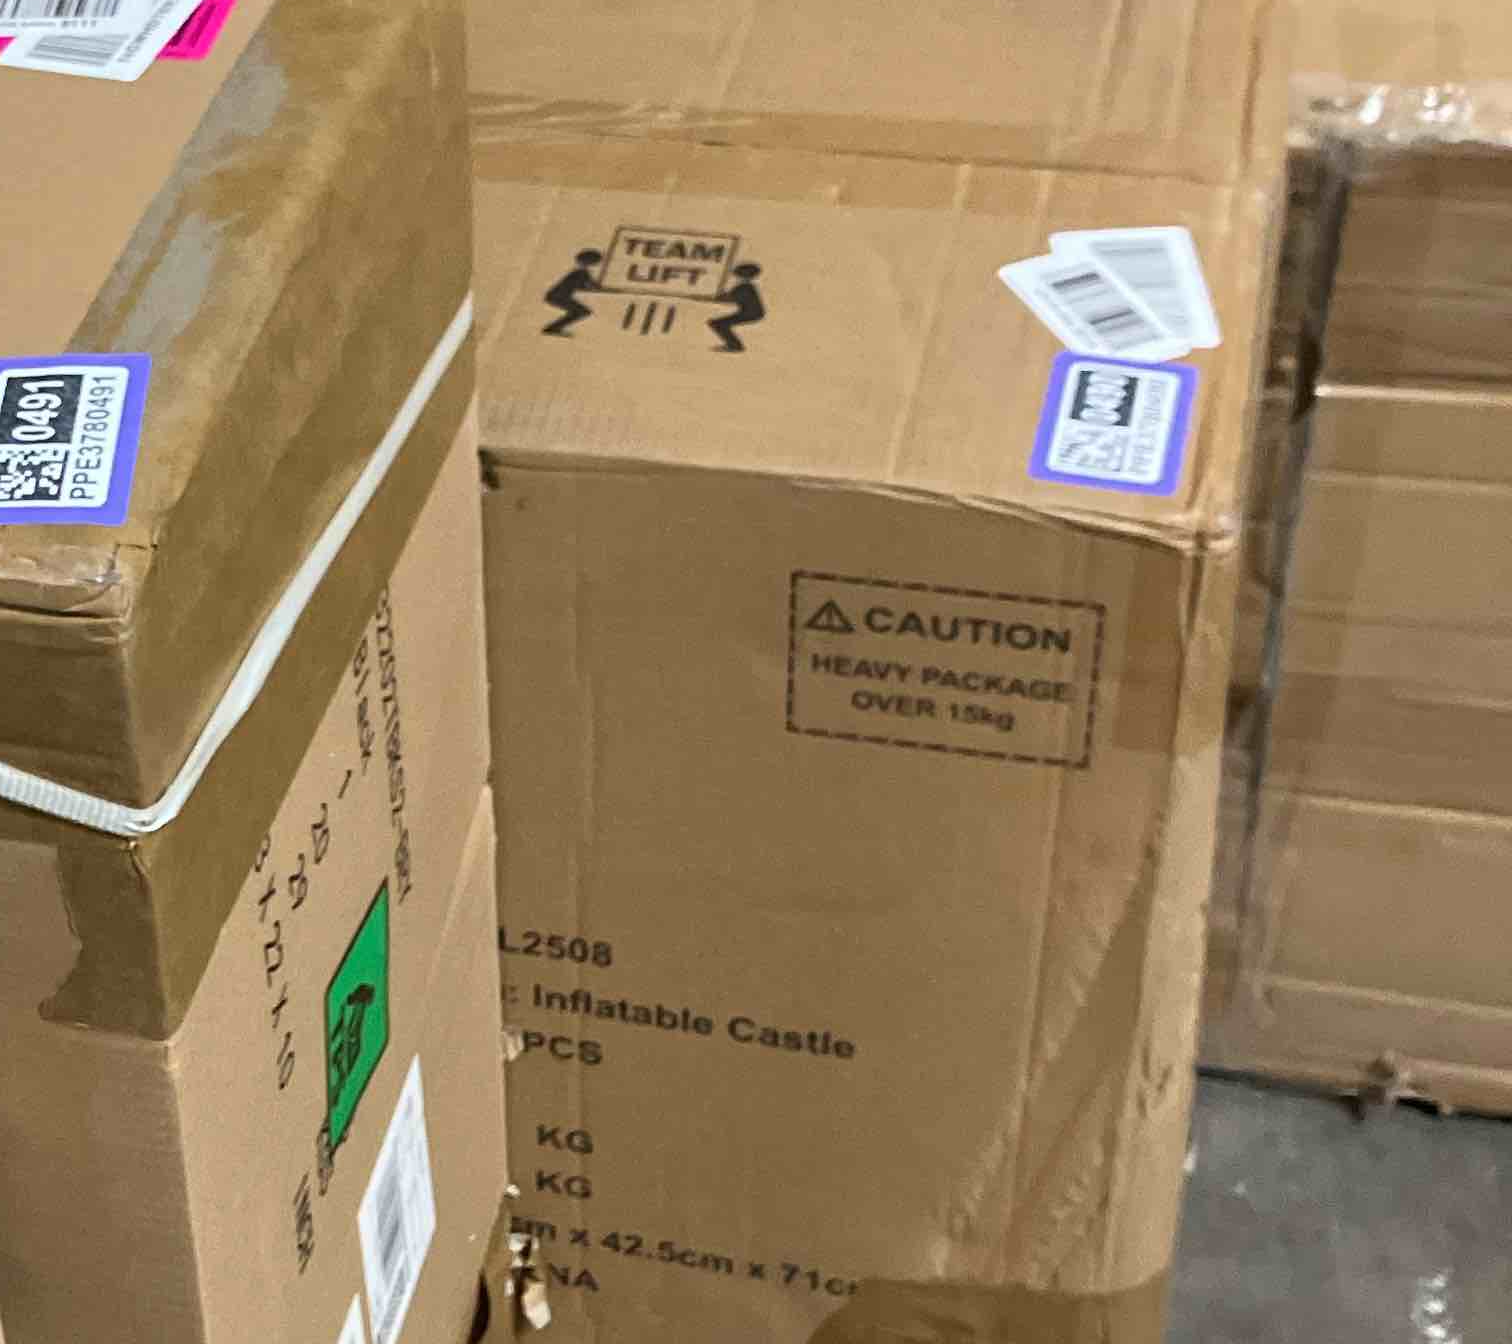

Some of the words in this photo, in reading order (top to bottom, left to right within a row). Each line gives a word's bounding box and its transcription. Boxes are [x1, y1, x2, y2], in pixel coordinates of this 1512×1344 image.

[623, 238, 726, 265] TEAM
[626, 263, 709, 287] LIFT
[11, 379, 65, 442] 0491
[69, 374, 118, 501] PPE3780491
[864, 606, 1071, 654] CAUTION
[810, 653, 912, 683] HEAVY
[920, 665, 1077, 703] PACKAGE
[851, 689, 936, 718] OVER
[949, 703, 1016, 733] 15kg
[498, 926, 613, 968] L2508
[533, 983, 714, 1036] Inflatable
[727, 1015, 856, 1060] Castle
[522, 1029, 605, 1067] PCS
[536, 1123, 594, 1155] KG
[535, 1169, 593, 1200] KG
[600, 1230, 734, 1275] 42.5cm
